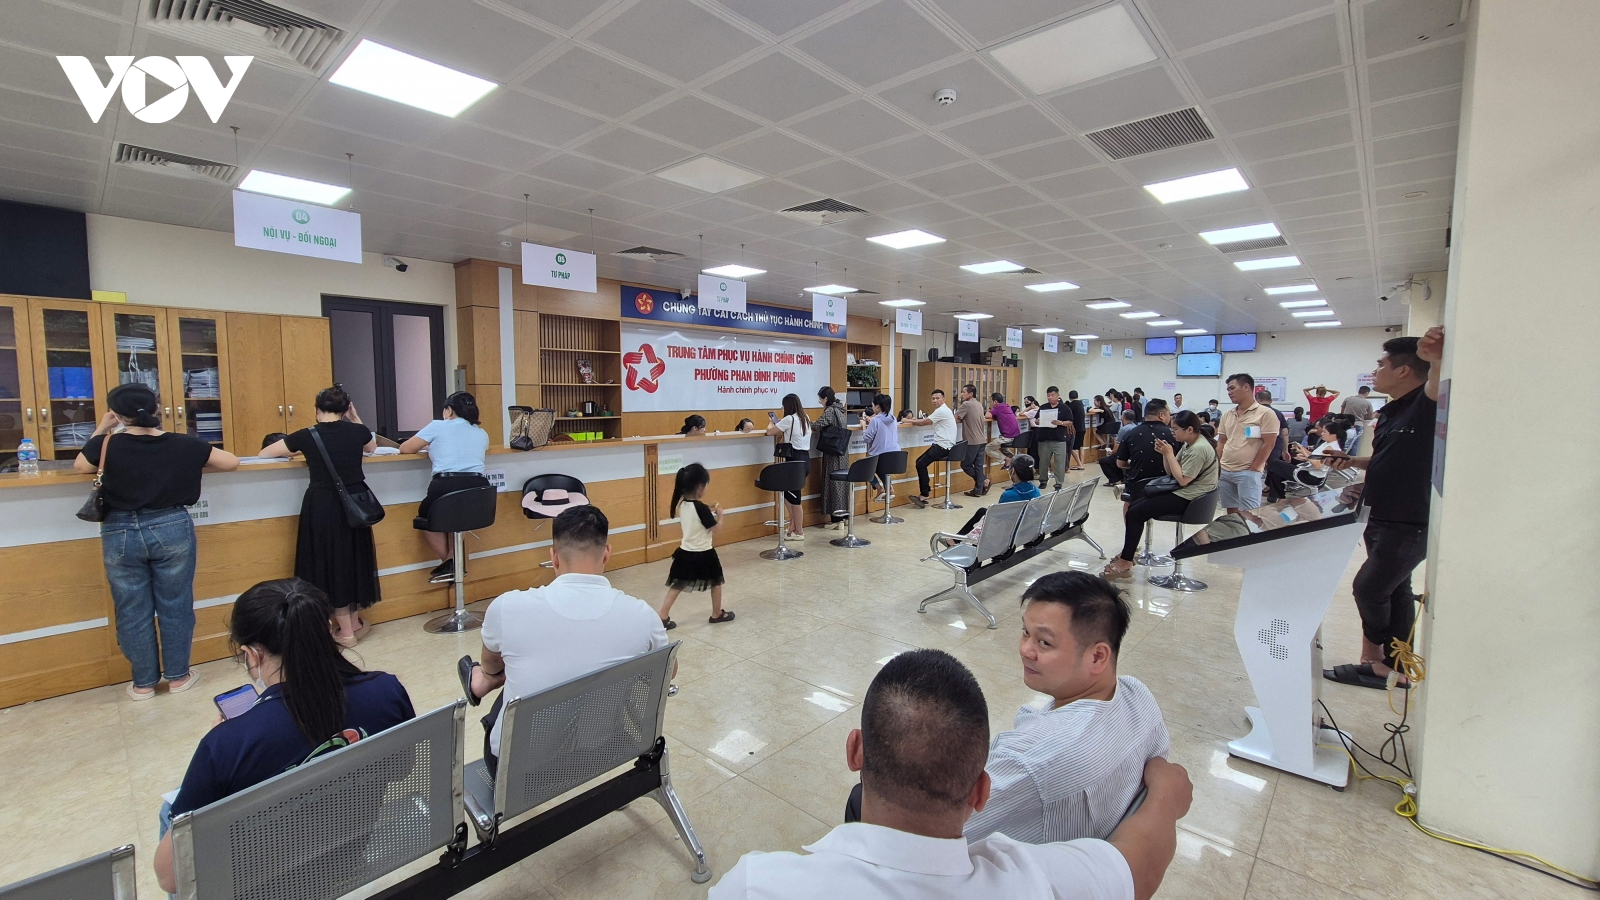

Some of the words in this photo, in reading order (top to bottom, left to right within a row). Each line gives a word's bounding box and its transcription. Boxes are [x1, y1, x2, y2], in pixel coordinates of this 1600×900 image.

[295, 211, 308, 222] 04
[263, 226, 278, 240] NỘI
[280, 229, 291, 242] VỤ
[298, 230, 312, 244] ĐỐI
[313, 234, 337, 249] NGOẠI
[557, 255, 566, 264] 05
[558, 271, 571, 280] PHÁP
[663, 301, 696, 315] CHUNG
[755, 310, 769, 323] THỦ
[770, 314, 784, 327] TỤC
[784, 314, 803, 327] HÀNH
[667, 345, 696, 359] TRUNG
[698, 345, 716, 360] TÂM
[717, 349, 738, 364] PHỤC
[740, 350, 750, 364] VỤ
[752, 349, 773, 363] HÀNH
[774, 351, 795, 364] CHÍNH
[796, 352, 814, 365] CÔNG
[694, 366, 729, 381] PHƯỜNG
[730, 369, 752, 382] PHAN
[754, 368, 772, 382] ĐÌNH
[772, 369, 796, 383] PHÙNG
[717, 385, 735, 394] Hành
[735, 386, 753, 394] chính
[753, 386, 769, 395] phục
